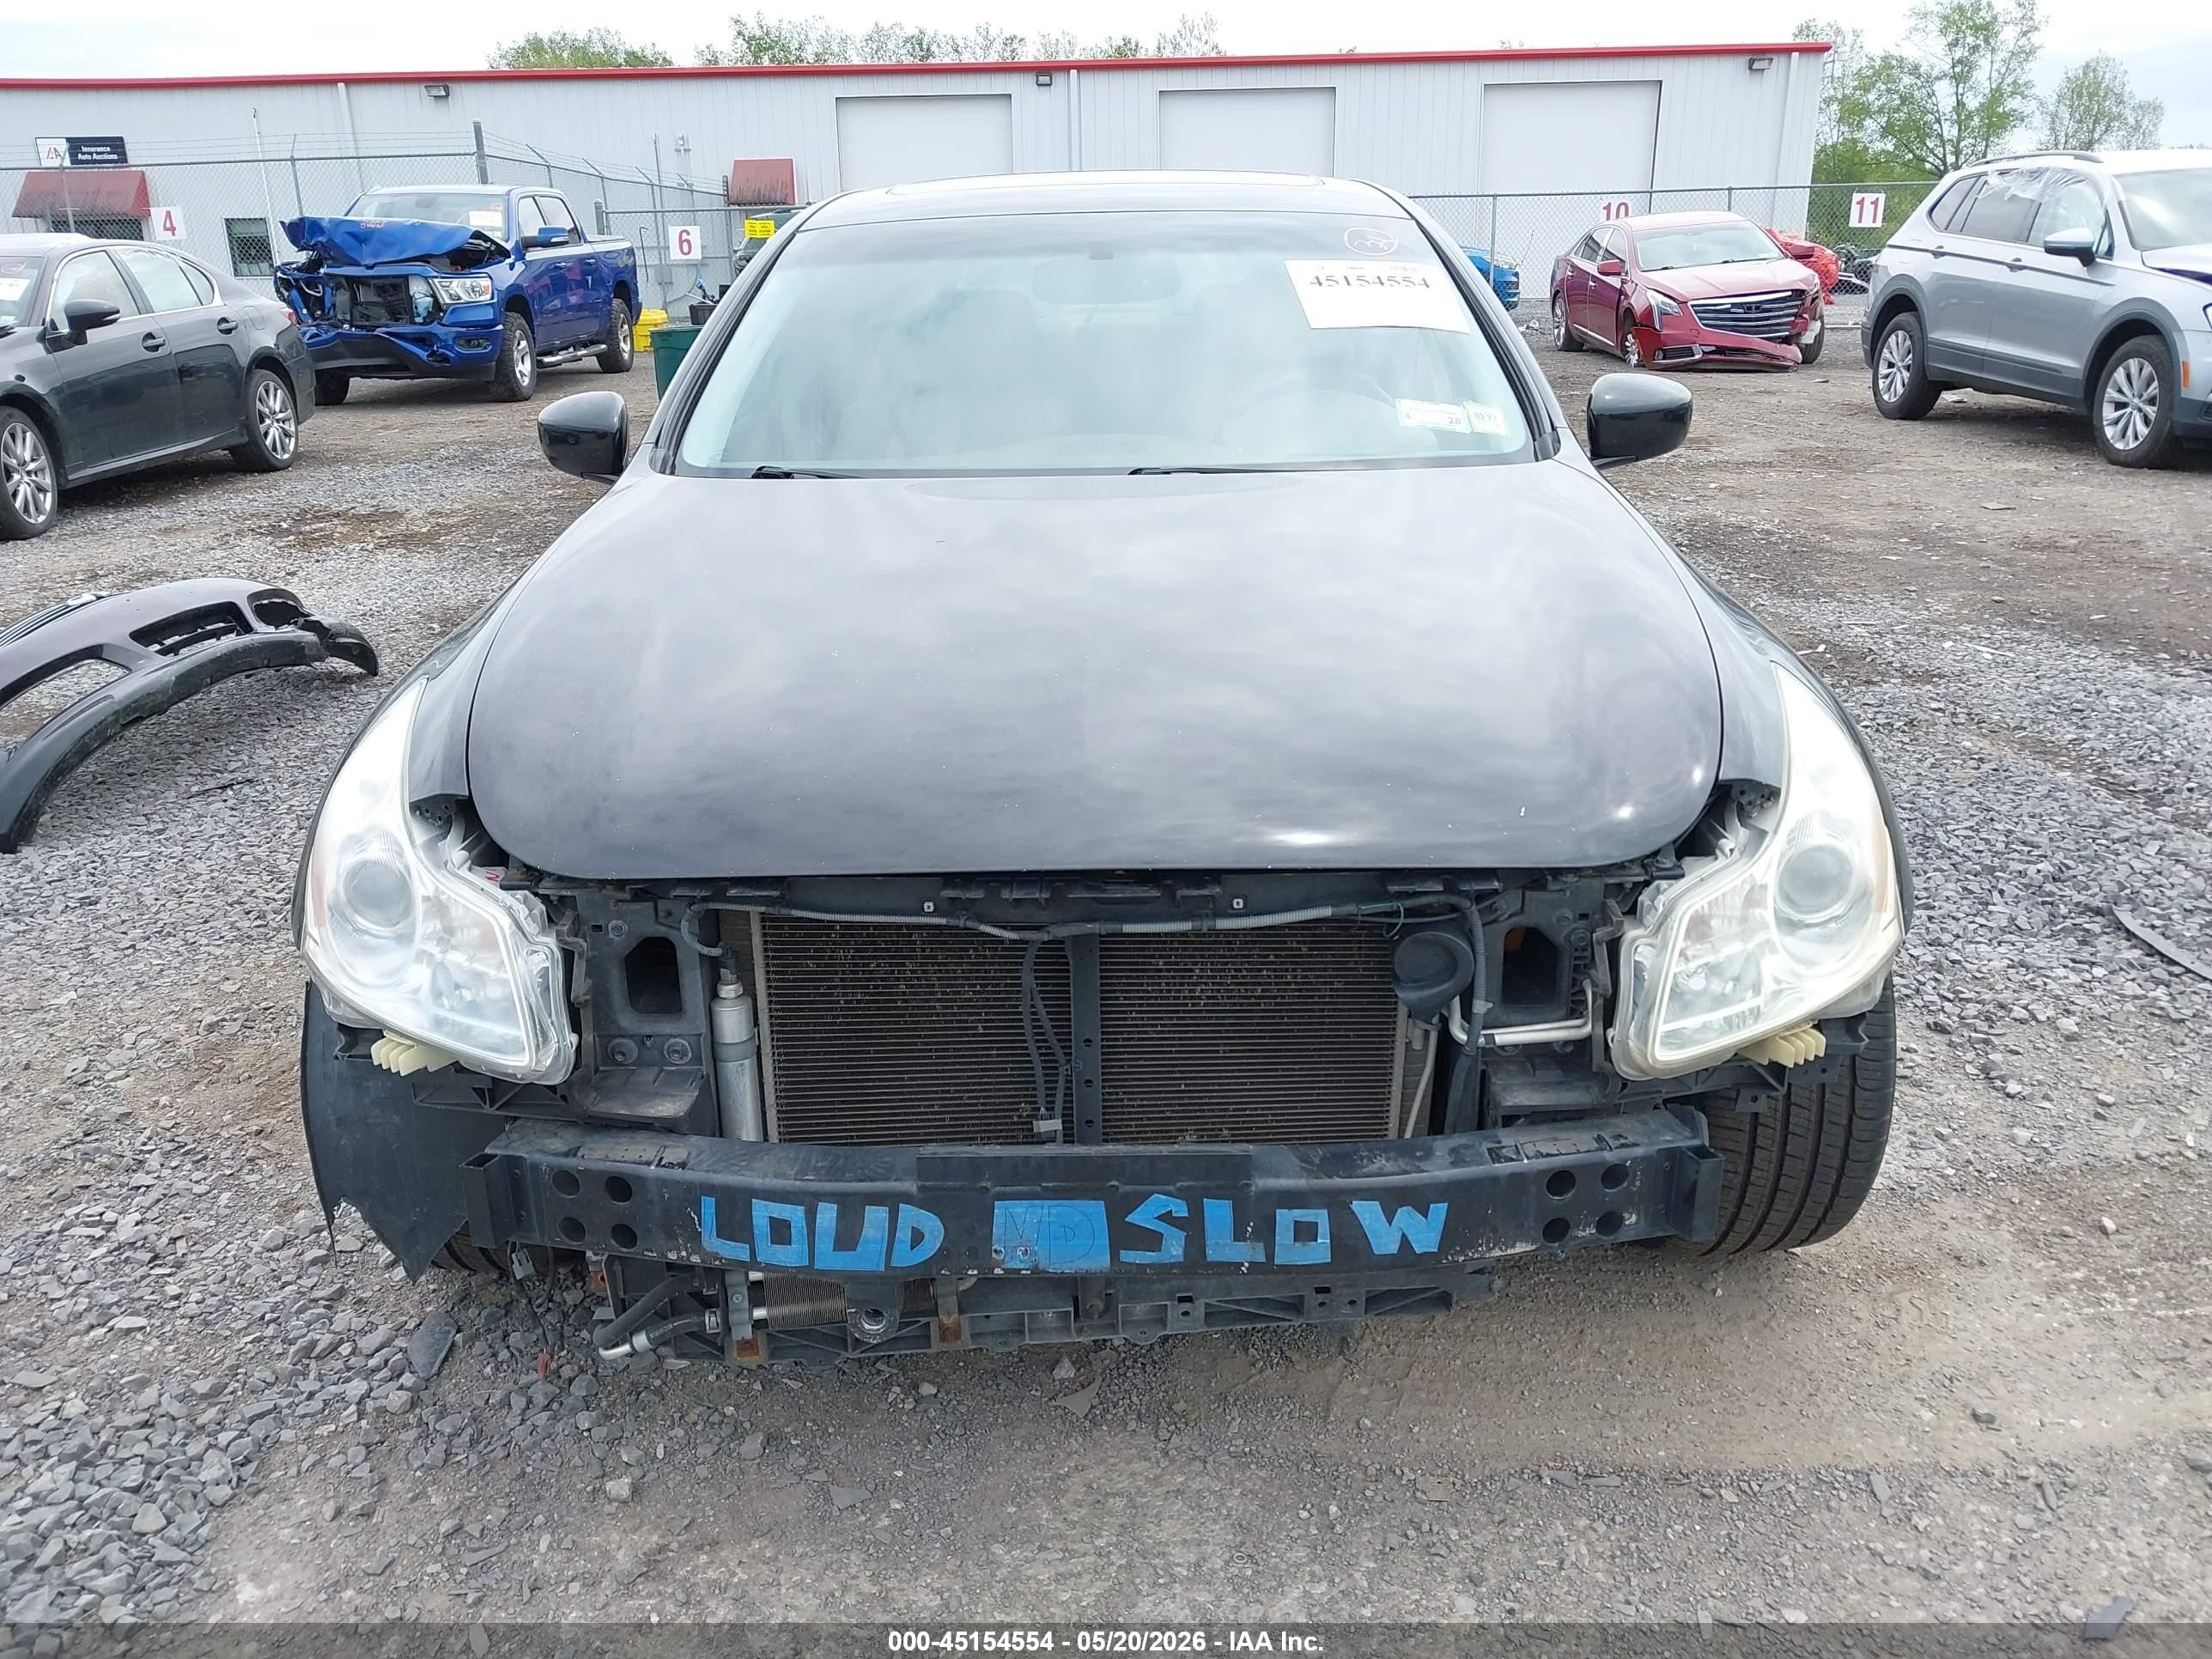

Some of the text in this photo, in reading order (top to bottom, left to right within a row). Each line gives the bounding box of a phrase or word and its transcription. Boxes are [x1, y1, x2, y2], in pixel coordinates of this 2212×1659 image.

[163, 210, 177, 237] 4
[1602, 202, 1630, 221] 10
[1856, 197, 1880, 224] 11
[678, 228, 692, 256] 6
[1310, 275, 1431, 289] 45154554
[701, 1195, 945, 1272] LOUD
[1119, 1193, 1449, 1266] SLOW
